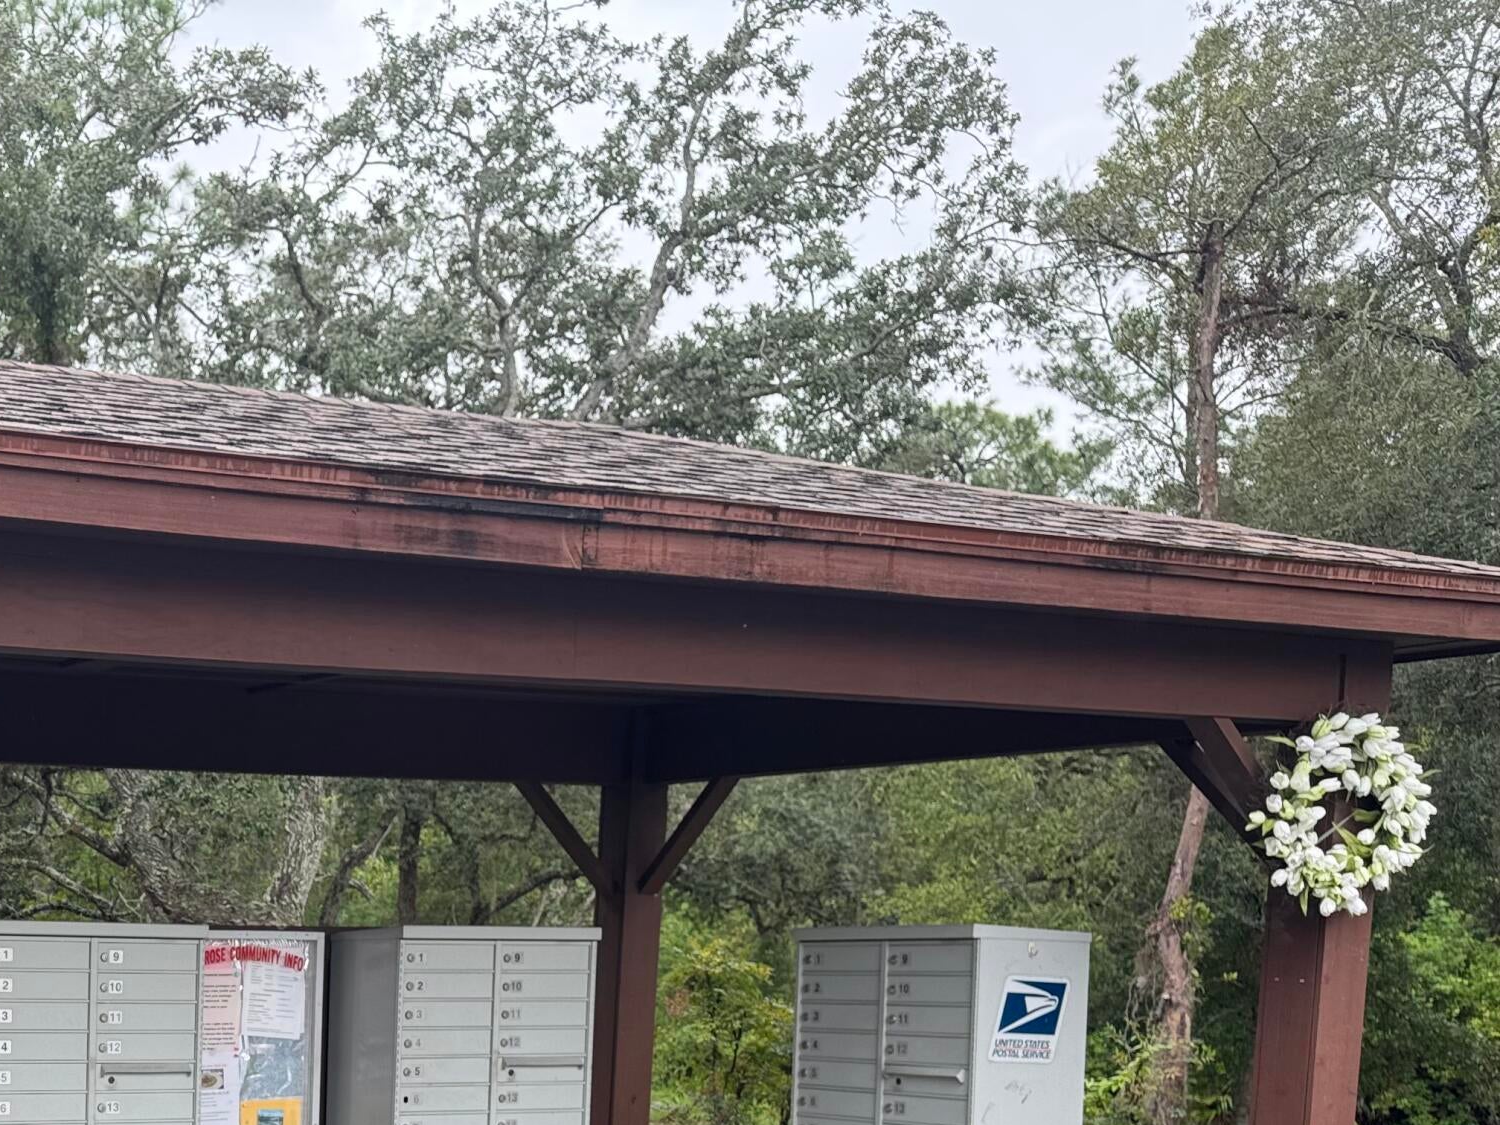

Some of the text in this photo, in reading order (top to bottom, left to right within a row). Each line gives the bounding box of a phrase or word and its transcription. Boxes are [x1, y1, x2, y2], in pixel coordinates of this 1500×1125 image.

[113, 952, 120, 962] 9
[229, 945, 281, 965] COMMUNITY
[284, 952, 304, 972] INFO
[2, 980, 10, 991] 2
[109, 982, 122, 992] 10
[417, 981, 424, 991] 2
[511, 981, 522, 992] 10
[899, 983, 909, 994] 10
[1, 1011, 9, 1021] 3
[110, 1013, 122, 1022] 11
[510, 1009, 521, 1019] 11
[1, 1042, 8, 1052] 4
[108, 1042, 121, 1052] 12
[509, 1037, 521, 1047] 12
[995, 1038, 1051, 1050] UNITED STATES
[897, 1043, 908, 1055] 12
[992, 1048, 1051, 1059] POSTAL SERVICE
[0, 1073, 8, 1083] 5
[0, 1103, 7, 1114] 6
[106, 1103, 120, 1113] 13
